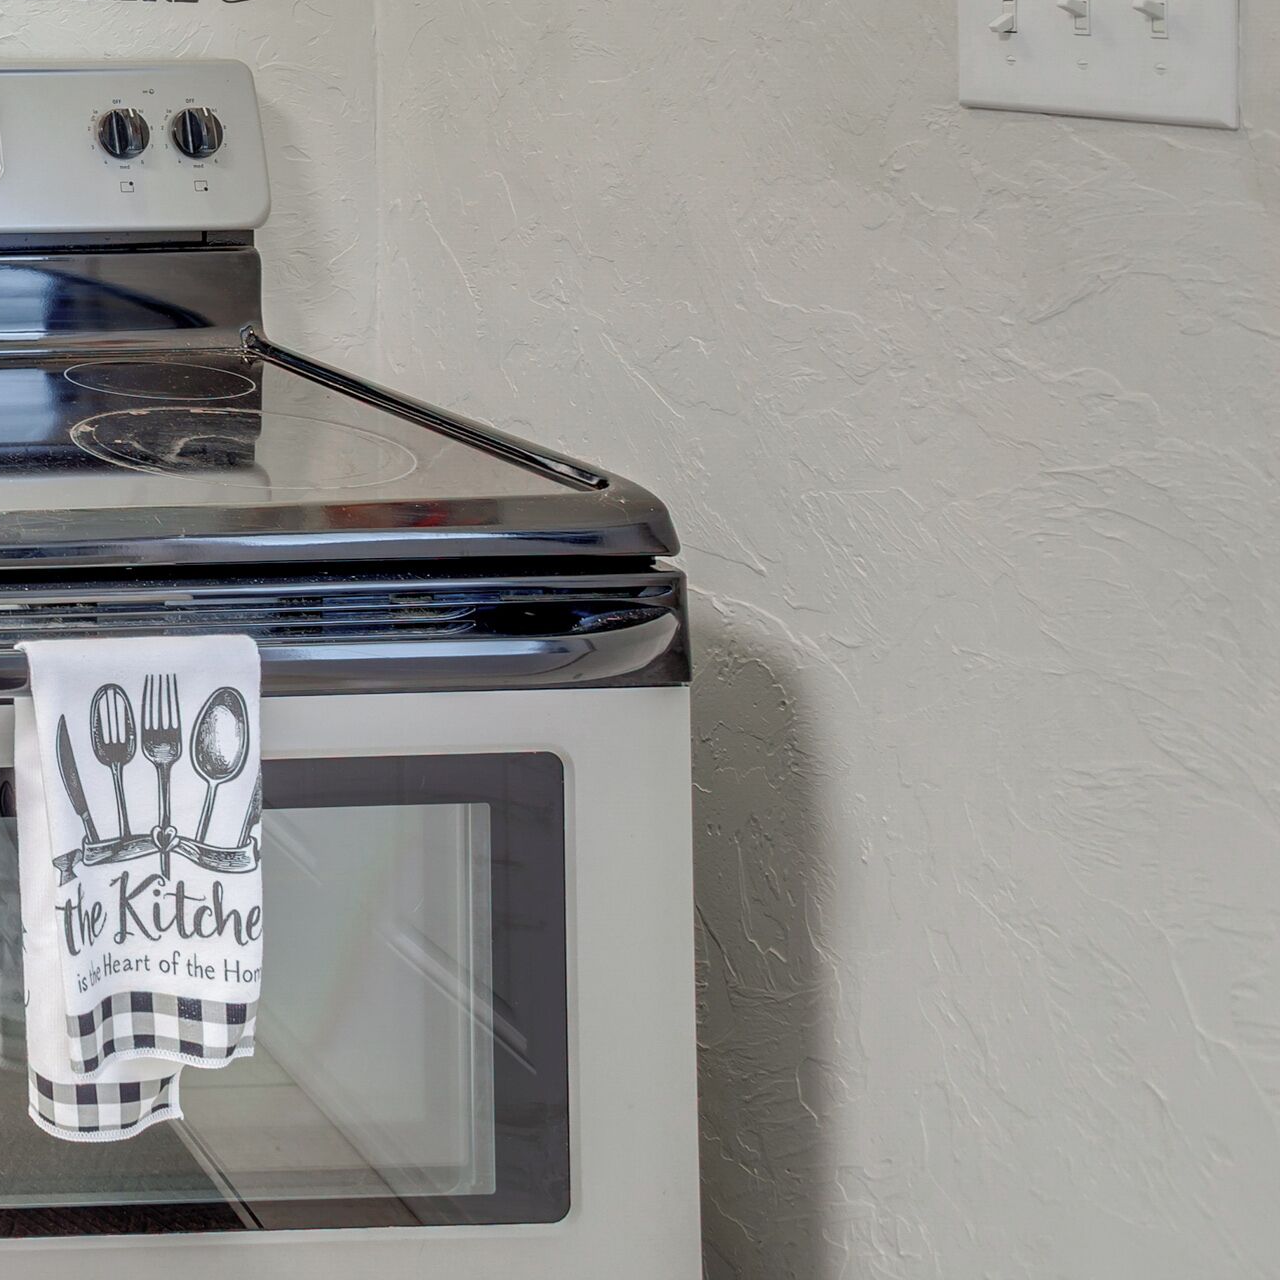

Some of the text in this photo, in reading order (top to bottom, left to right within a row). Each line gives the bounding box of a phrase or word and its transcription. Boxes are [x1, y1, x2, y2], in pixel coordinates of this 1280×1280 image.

[55, 870, 263, 956] the Kitche
[77, 973, 88, 994] is
[89, 960, 102, 987] the
[103, 951, 151, 977] Heart
[159, 950, 180, 976] of
[186, 953, 215, 980] the
